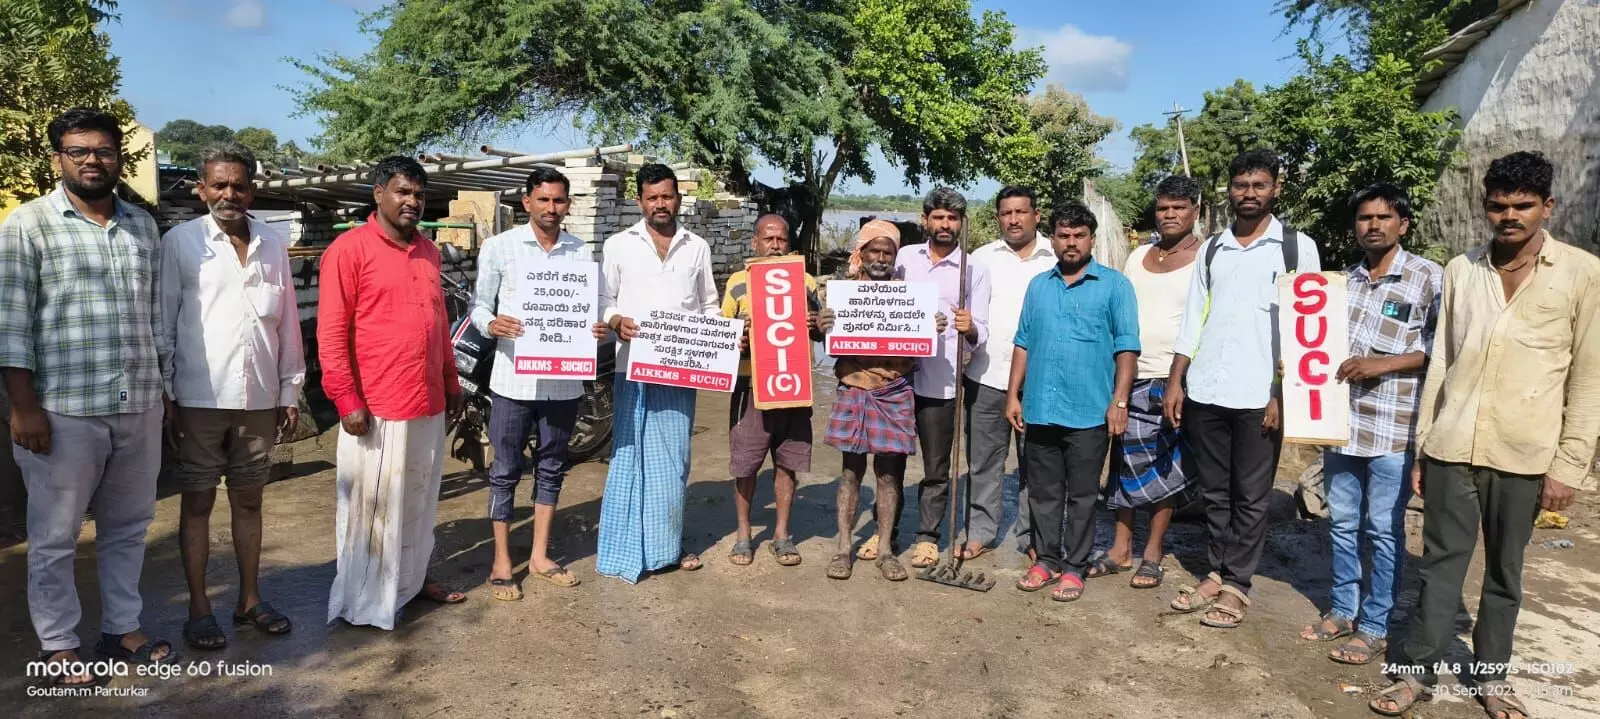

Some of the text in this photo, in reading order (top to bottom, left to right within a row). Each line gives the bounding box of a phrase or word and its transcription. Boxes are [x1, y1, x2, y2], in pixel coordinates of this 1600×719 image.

[526, 270, 559, 281] ಎಕರೆಗೆ
[534, 288, 580, 299] 25,000/-
[858, 283, 907, 294] ಮಳೆಯಿಂದ
[848, 296, 915, 306] ಹಾನಿಗೊಳಗಾದ
[522, 302, 591, 314] ರೂಪಾಯಿ ಬೆಳೆ
[650, 310, 731, 328] ಪ್ರತಿವರ್ಷ ಮಳೆಯಿಂದ
[838, 308, 887, 322] ಮನೆಗಳನ್ನು
[525, 318, 587, 331] ನಷ್ಟ ಪರಿಹಾರ
[640, 320, 737, 340] ಹಾನಿಗೊಳಗಾದ ಮನೆಗಳಿಗೆ
[842, 322, 874, 333] ಪುನರ್
[663, 334, 736, 351] ಪರಿಹಾರವಾಗುವಂತೆ
[832, 340, 878, 350] AIKKMS
[888, 342, 930, 352] SUCI(C)
[1293, 272, 1330, 420] SUCI
[517, 360, 552, 372] AIKKMS
[560, 360, 593, 373] SUCI(C)
[633, 367, 680, 381] AIKKMS
[690, 374, 730, 388] SUCI(C)
